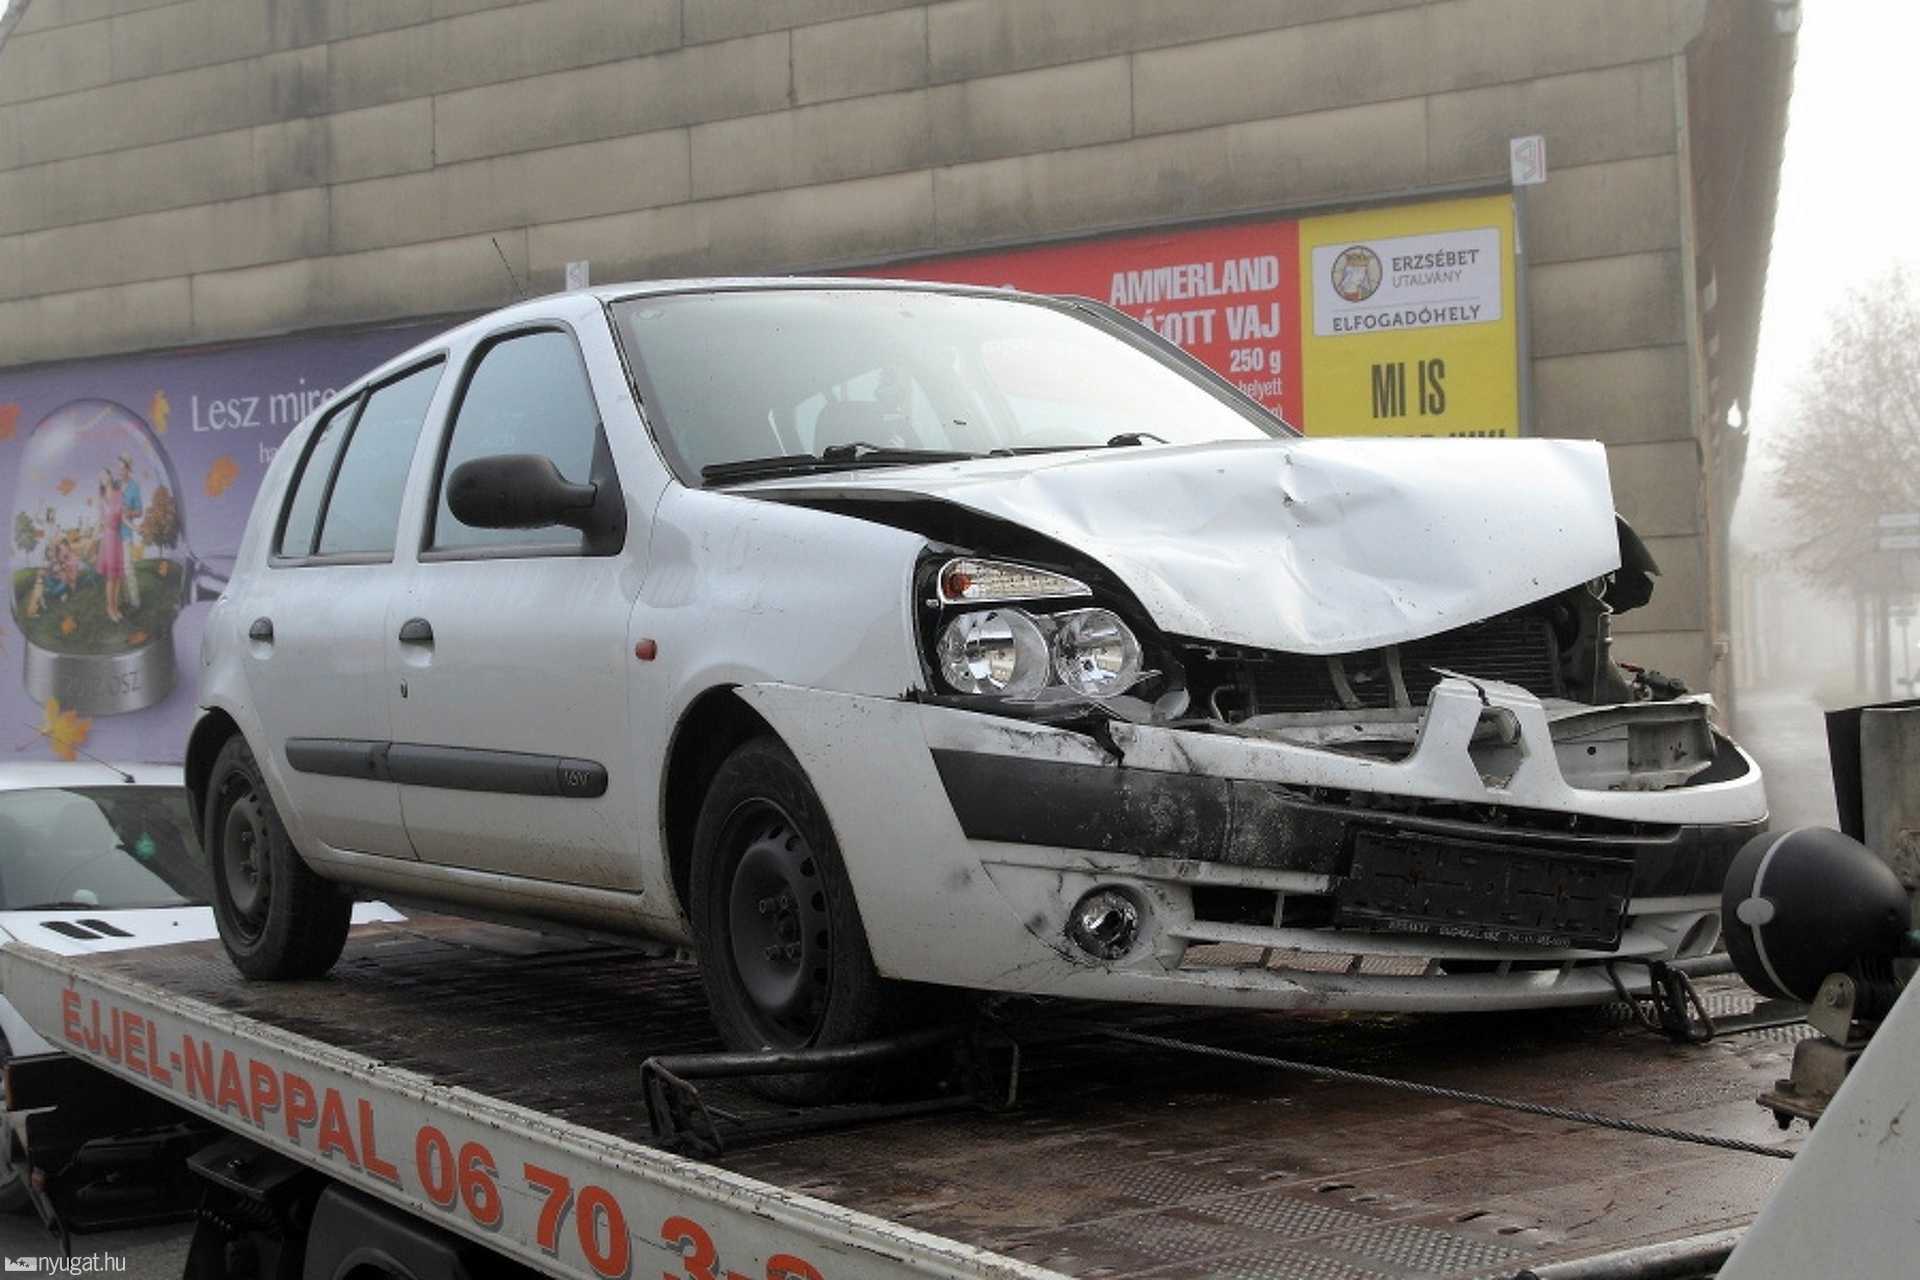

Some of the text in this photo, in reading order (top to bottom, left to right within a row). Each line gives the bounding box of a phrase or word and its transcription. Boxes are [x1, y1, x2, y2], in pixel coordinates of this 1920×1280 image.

[1392, 249, 1480, 272] ERZSÉBET
[1392, 270, 1462, 288] UTALVÁNY
[1109, 255, 1280, 306] AMMERLAND
[1226, 302, 1280, 341] VAJ
[1332, 304, 1481, 331] ELFOGADÓHELY
[1230, 347, 1281, 374] 250 g
[1371, 358, 1446, 419] MI IS
[192, 395, 261, 432] Lesz
[63, 972, 401, 1186] ÉJJEL-NAPPAL
[416, 1125, 502, 1230] 06
[523, 1162, 631, 1280] 70
